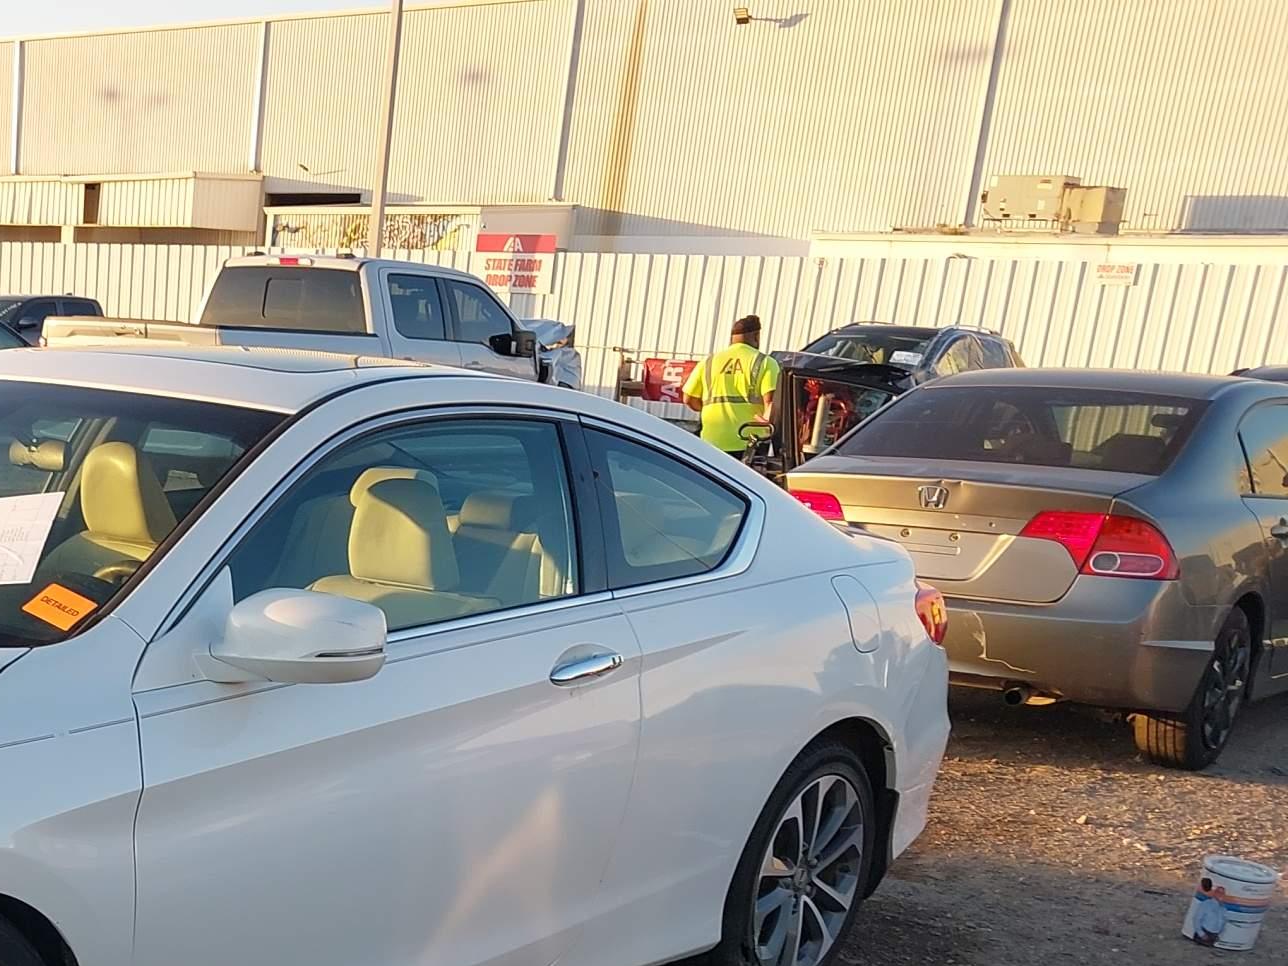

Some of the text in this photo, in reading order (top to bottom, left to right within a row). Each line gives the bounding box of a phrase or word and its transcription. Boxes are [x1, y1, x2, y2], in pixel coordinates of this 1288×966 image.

[484, 258, 543, 272] STATE FARM
[486, 274, 537, 288] DROP ZONE
[39, 595, 80, 617] DETAILED
